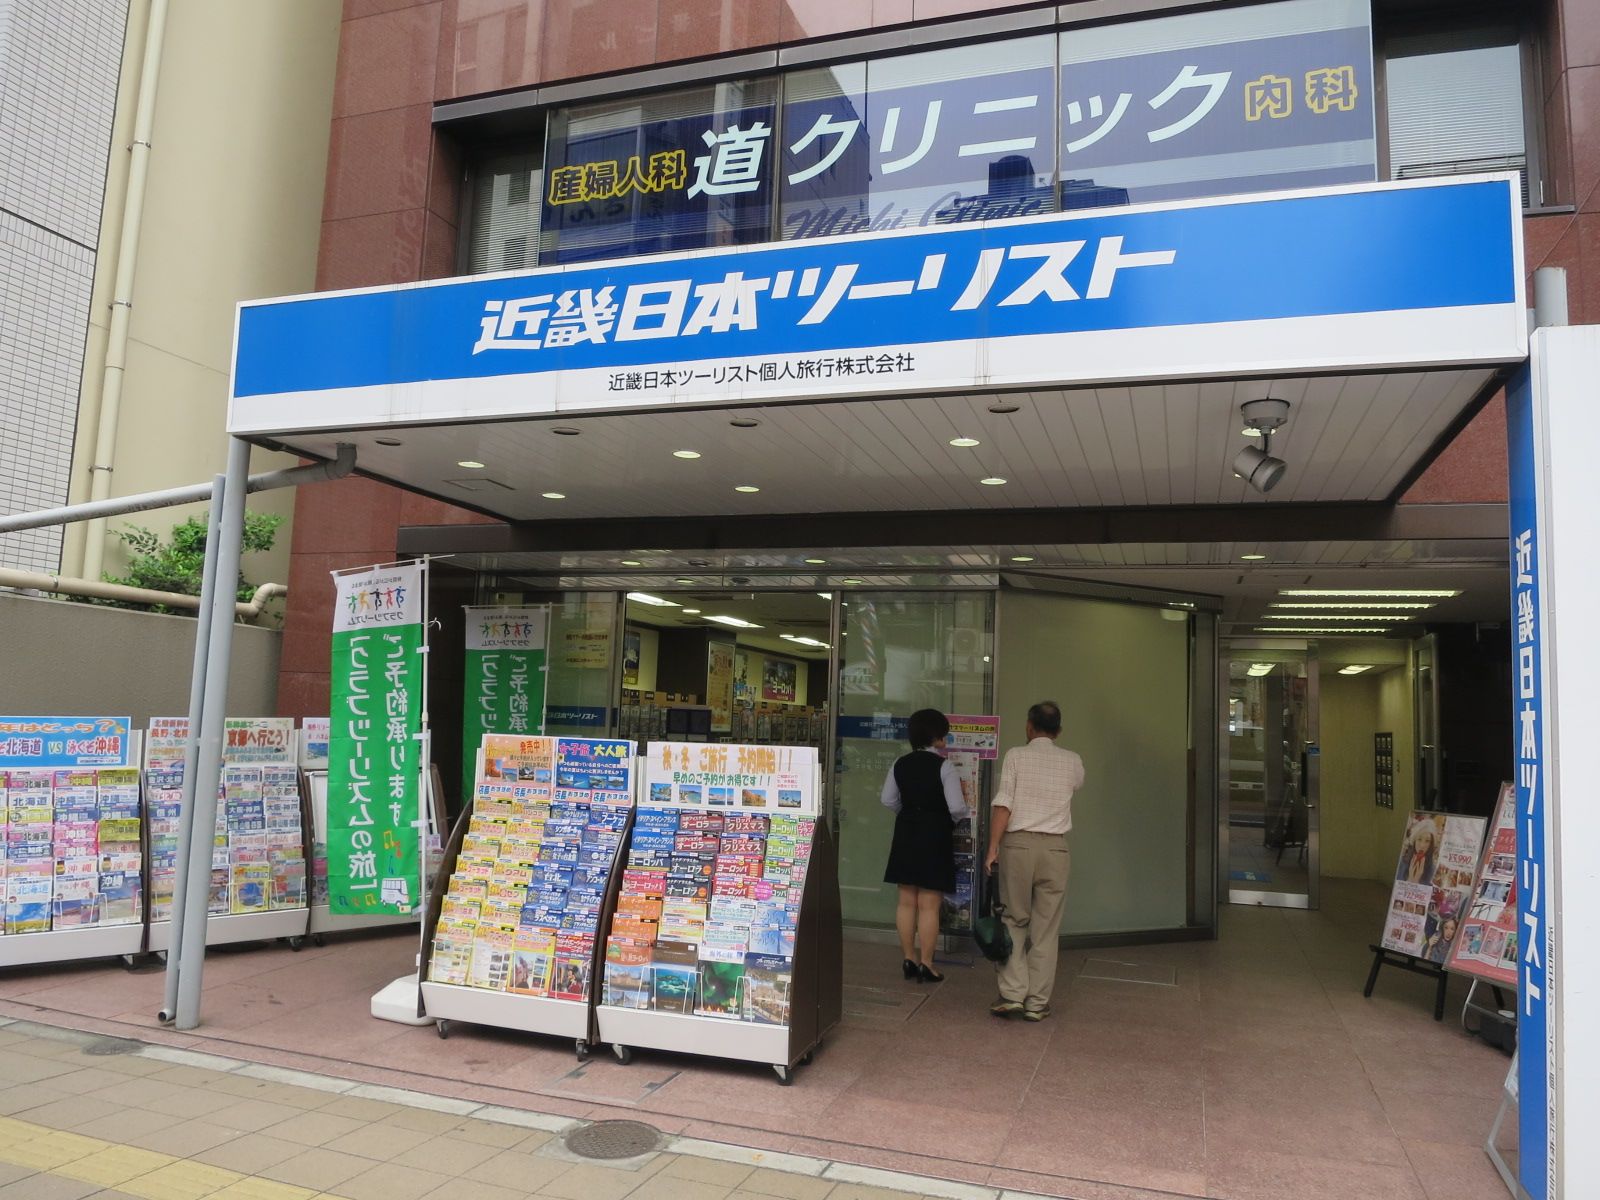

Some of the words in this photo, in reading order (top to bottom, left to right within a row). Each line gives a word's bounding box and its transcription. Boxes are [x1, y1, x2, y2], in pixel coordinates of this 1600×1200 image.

[549, 149, 687, 206] 産婦人科
[687, 65, 1232, 200] 道クリニック
[1245, 66, 1358, 121] 内科
[786, 201, 907, 241] Michi
[472, 235, 1177, 356] 近畿日本ツーリスト
[608, 352, 916, 393] 近畿日本ツーリスト個人旅行株式会社
[1512, 529, 1542, 1018] 近畿日本ツーリスト
[671, 863, 702, 874] オーロラ
[666, 885, 698, 896] オーロラ
